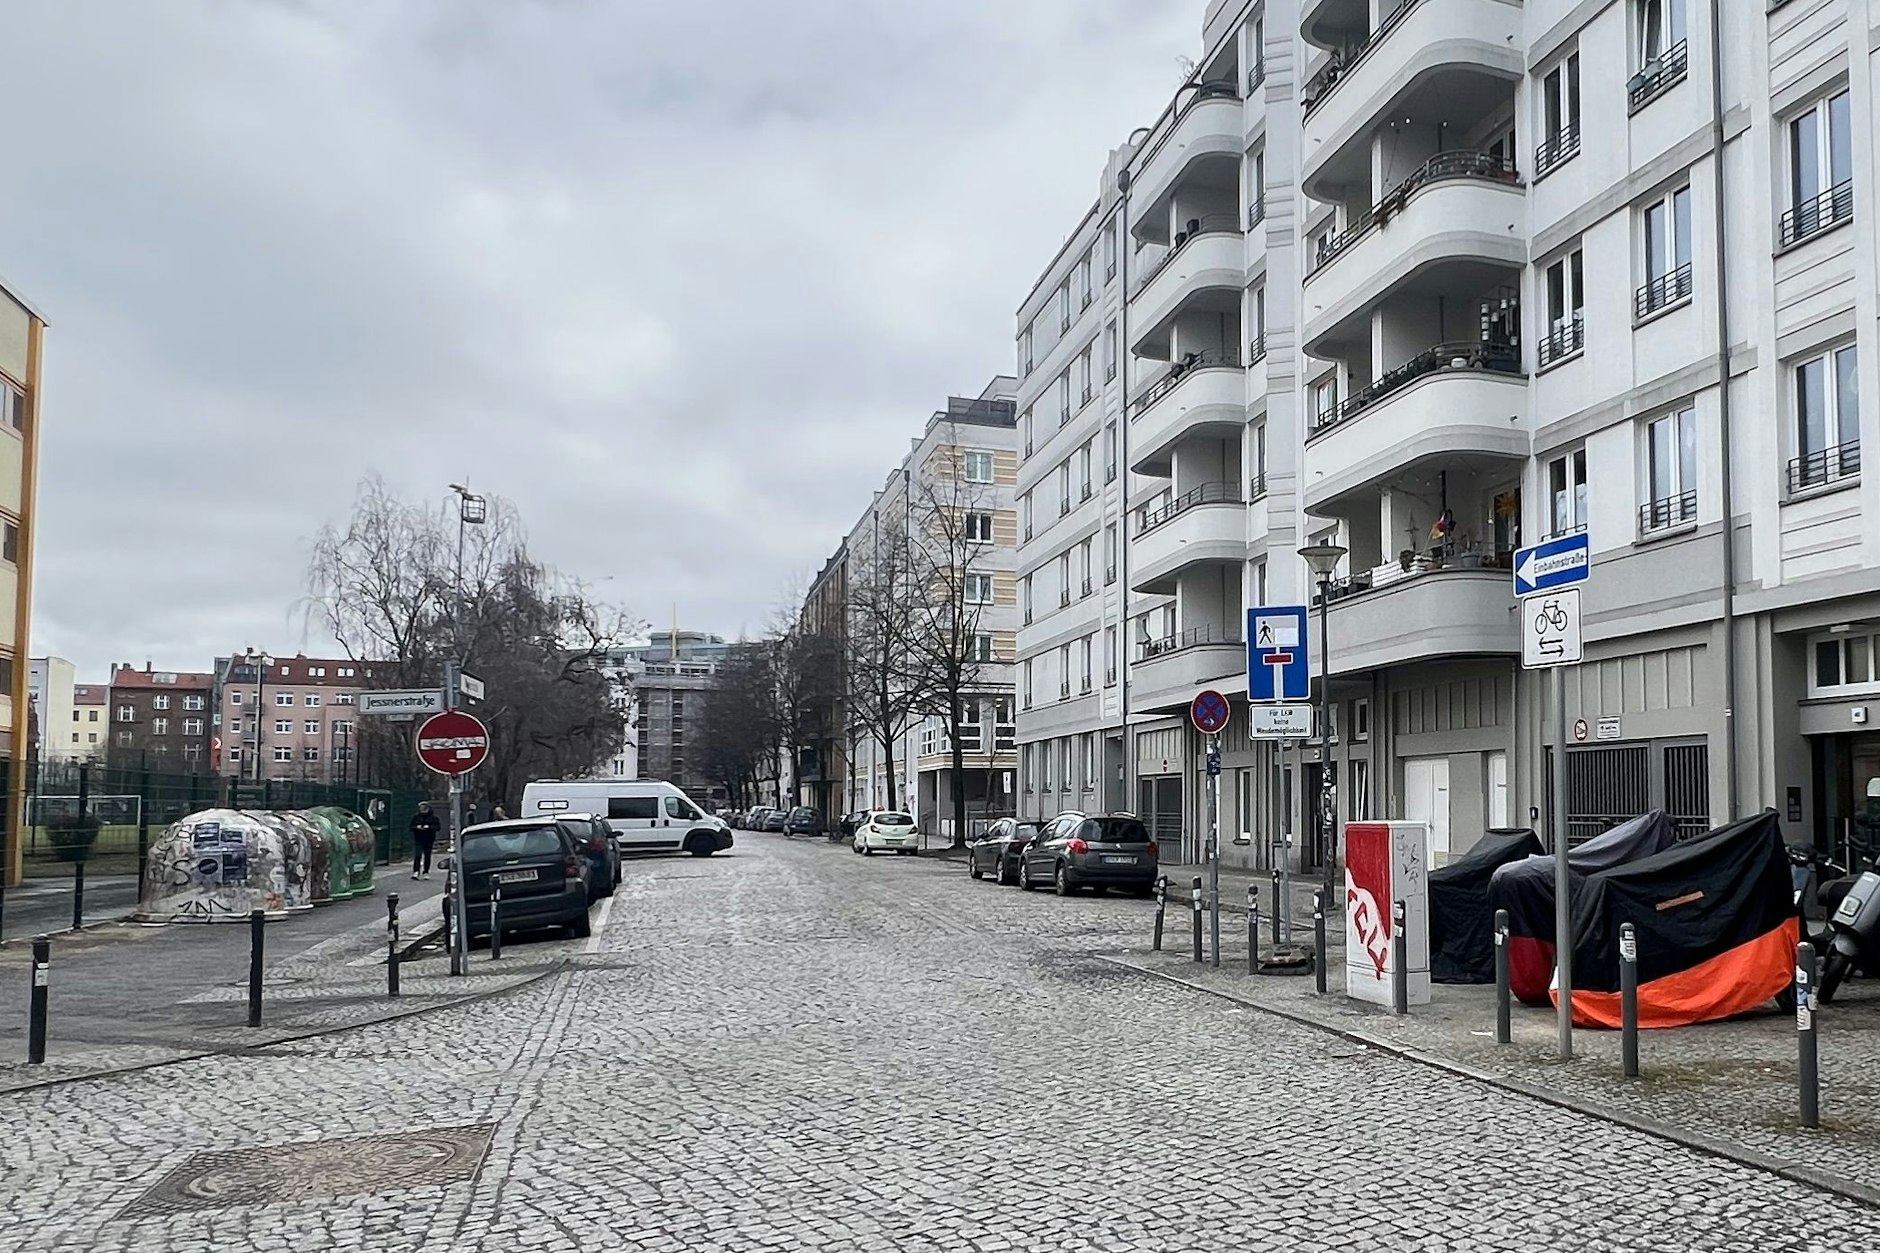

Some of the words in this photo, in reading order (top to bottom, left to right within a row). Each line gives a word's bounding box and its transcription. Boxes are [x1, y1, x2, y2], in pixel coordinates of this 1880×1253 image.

[1534, 552, 1585, 574] Einbahnstraße
[366, 695, 435, 709] Jessnerstraße
[1269, 709, 1279, 717] Für
